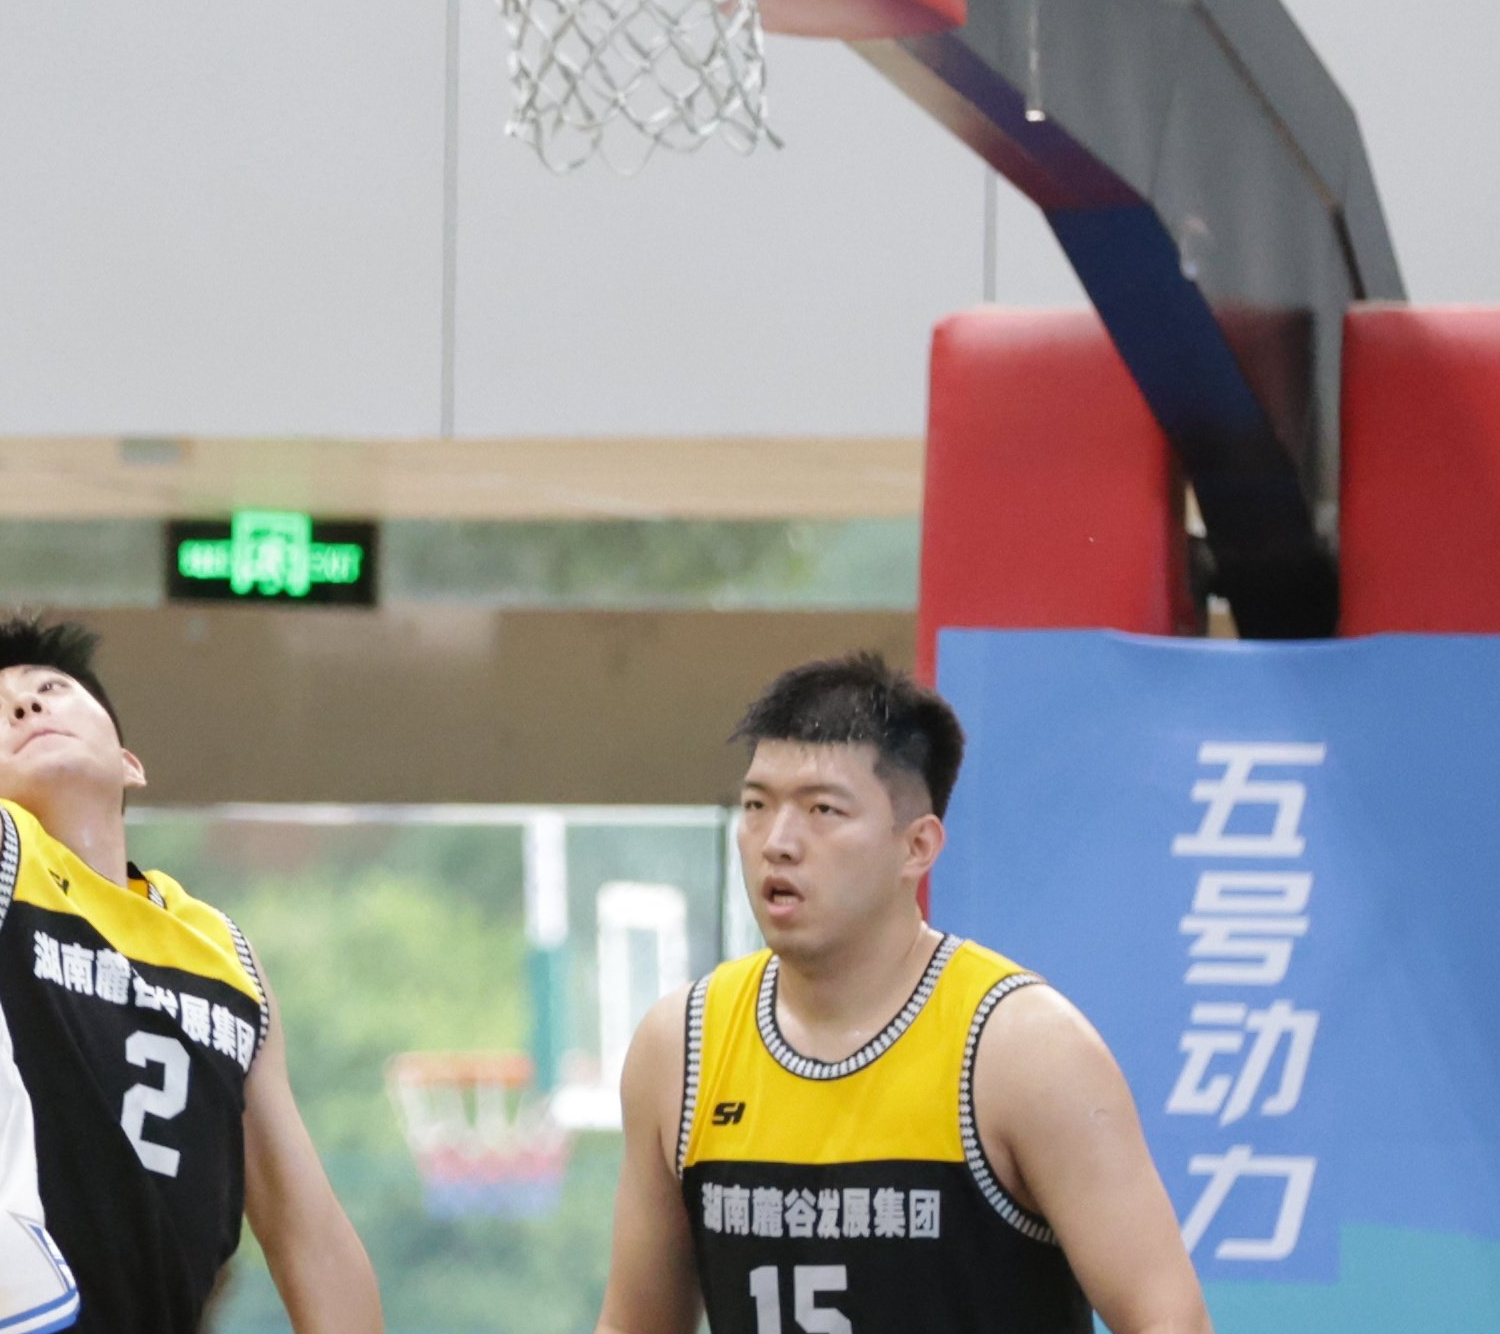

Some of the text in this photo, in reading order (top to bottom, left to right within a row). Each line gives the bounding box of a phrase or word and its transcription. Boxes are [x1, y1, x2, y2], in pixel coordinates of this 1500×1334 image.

[1167, 741, 1326, 1261] 五号动力
[120, 1029, 191, 1178] 2
[701, 1181, 942, 1240] 湖南麓谷发展集团
